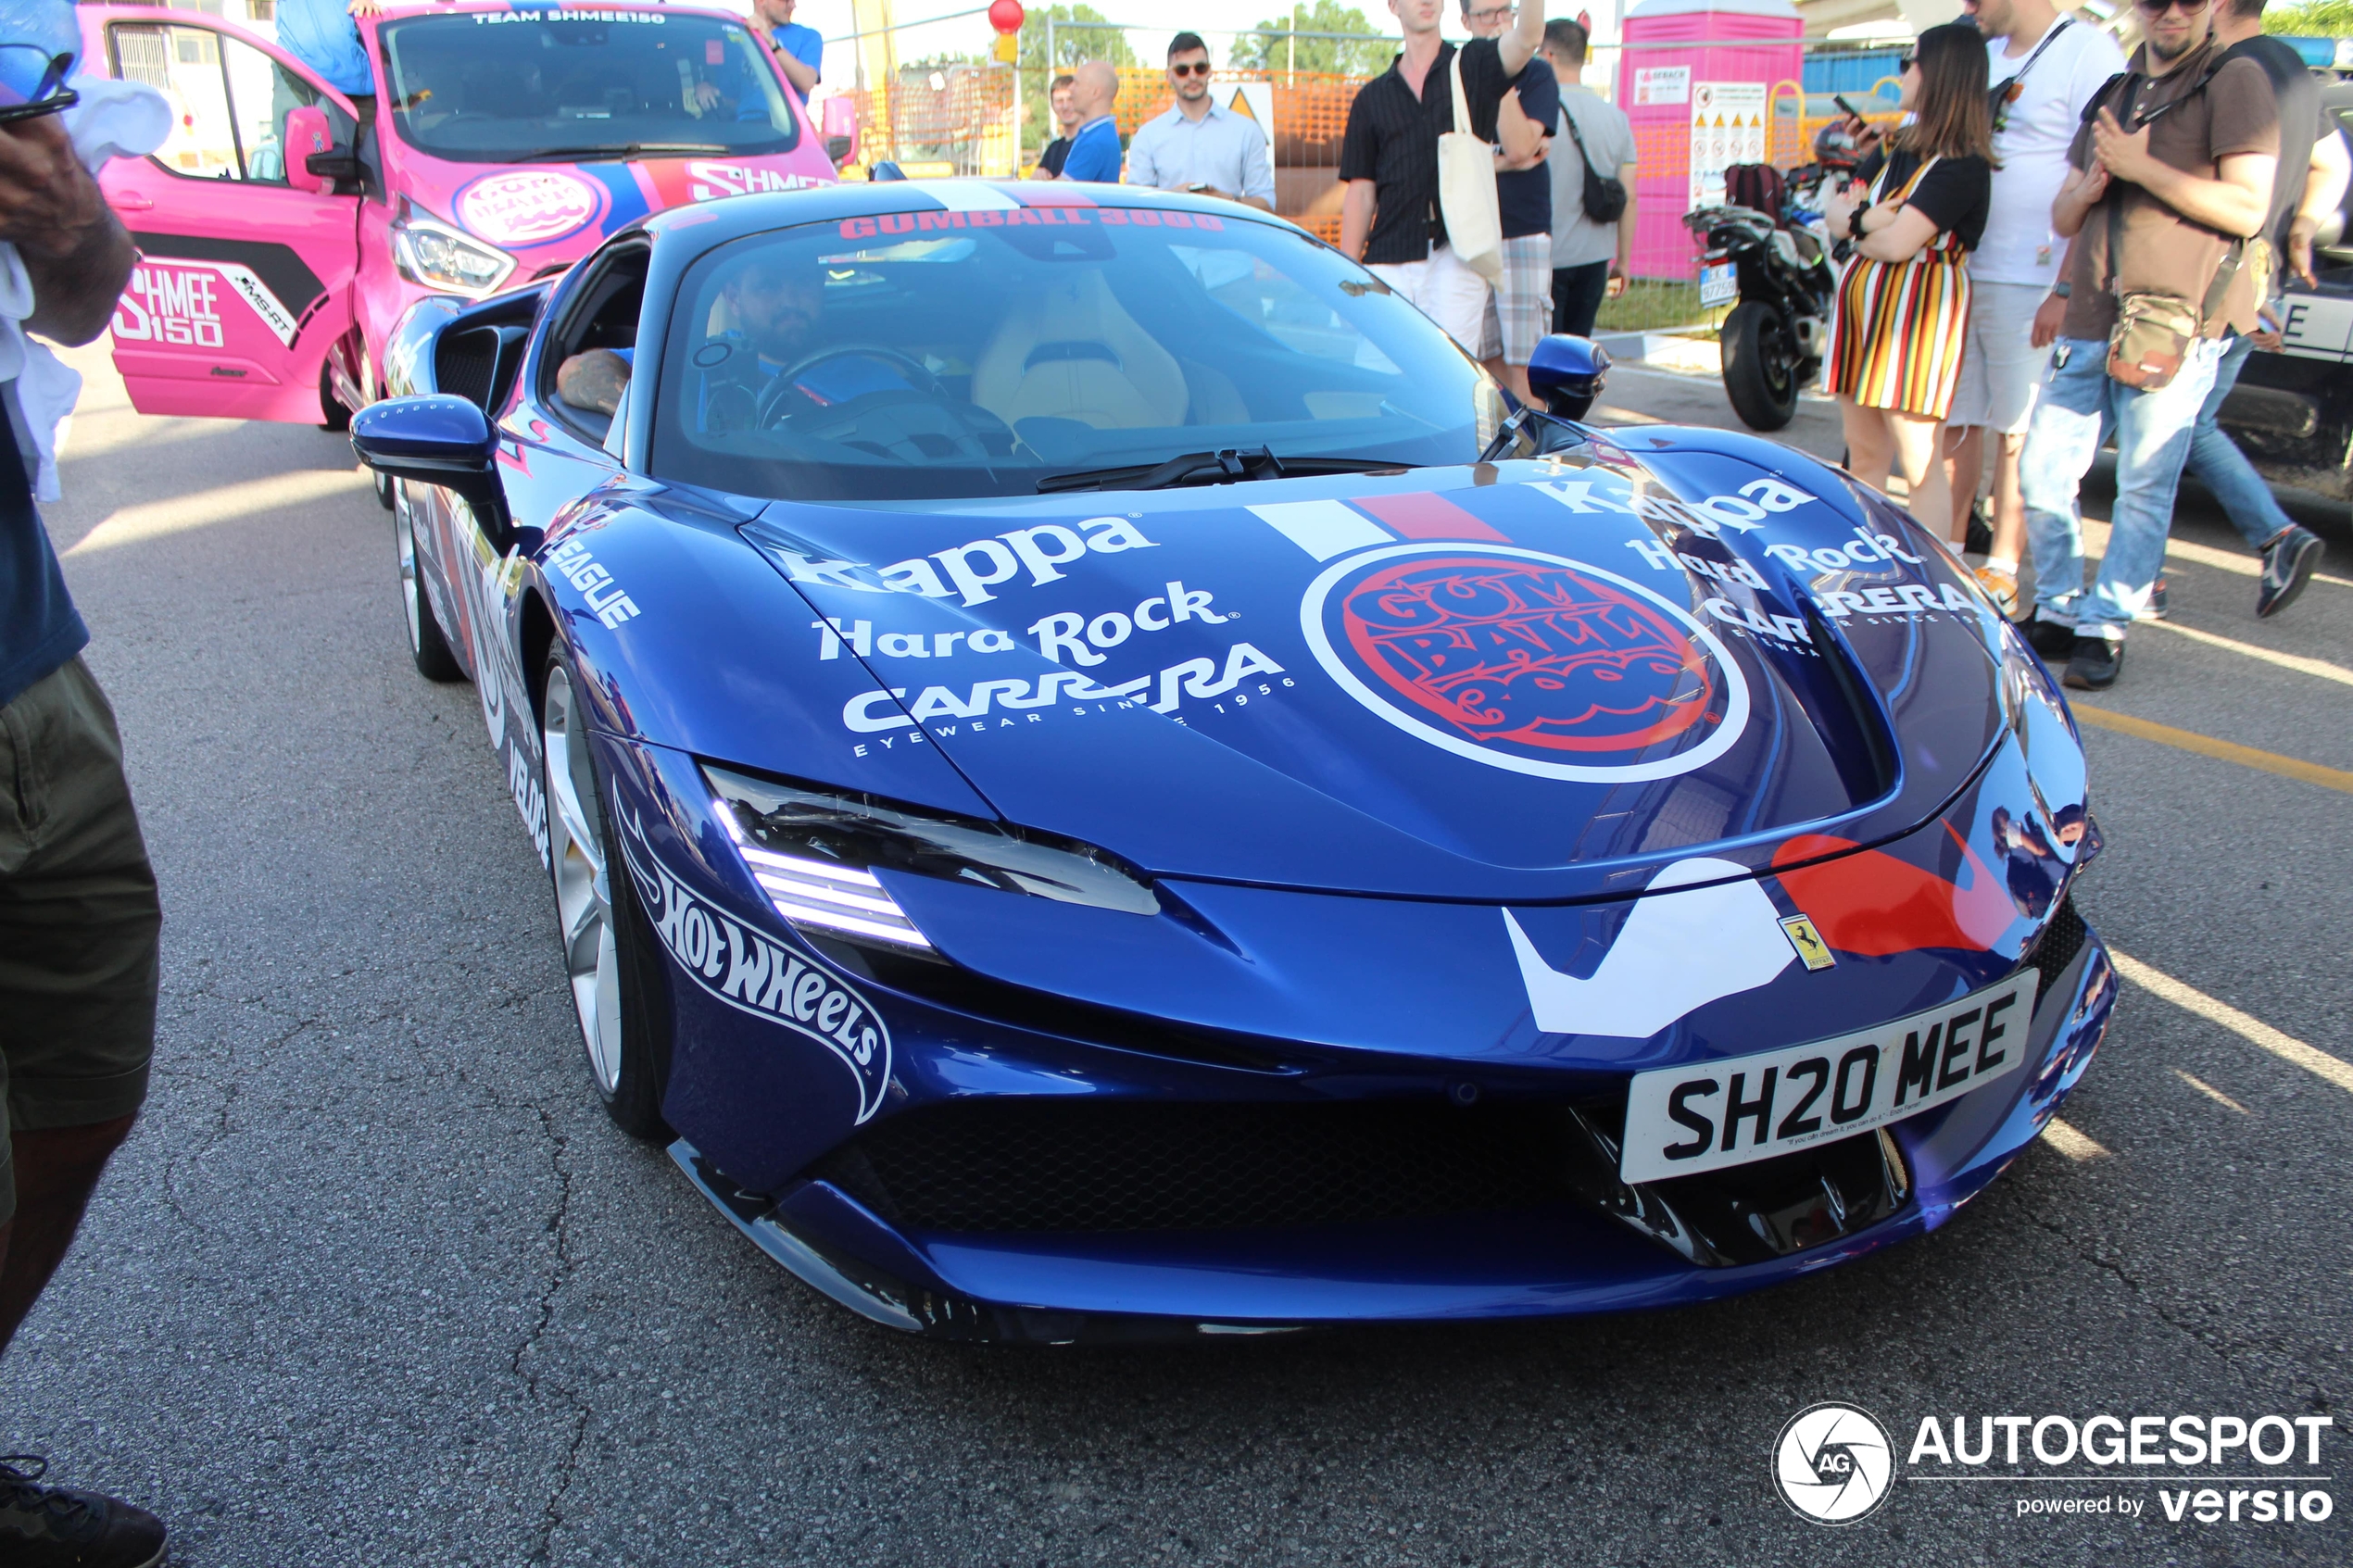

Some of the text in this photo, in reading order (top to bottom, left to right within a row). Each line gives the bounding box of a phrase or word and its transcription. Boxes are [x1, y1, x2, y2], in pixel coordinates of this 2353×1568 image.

[472, 10, 666, 24] TEAM SHMEE150
[839, 207, 1225, 240] GUMBALL 3000
[111, 268, 220, 341] SHMEE
[151, 316, 224, 348] 150
[366, 404, 455, 424] LONDON
[1519, 478, 1818, 540] Kappa
[543, 538, 641, 630] LEAGUE
[764, 516, 1161, 608] Kappa
[1624, 525, 1922, 591] Hard Rock
[1027, 581, 1229, 667] Rock
[843, 642, 1285, 733] CARRERA
[853, 712, 1042, 758] EYEWEAR
[1214, 676, 1296, 715] 1956
[1663, 991, 2017, 1161] SH20 MEE
[1794, 1136, 1806, 1146] you
[1819, 1127, 1839, 1138] dream
[1846, 1123, 1857, 1131] you
